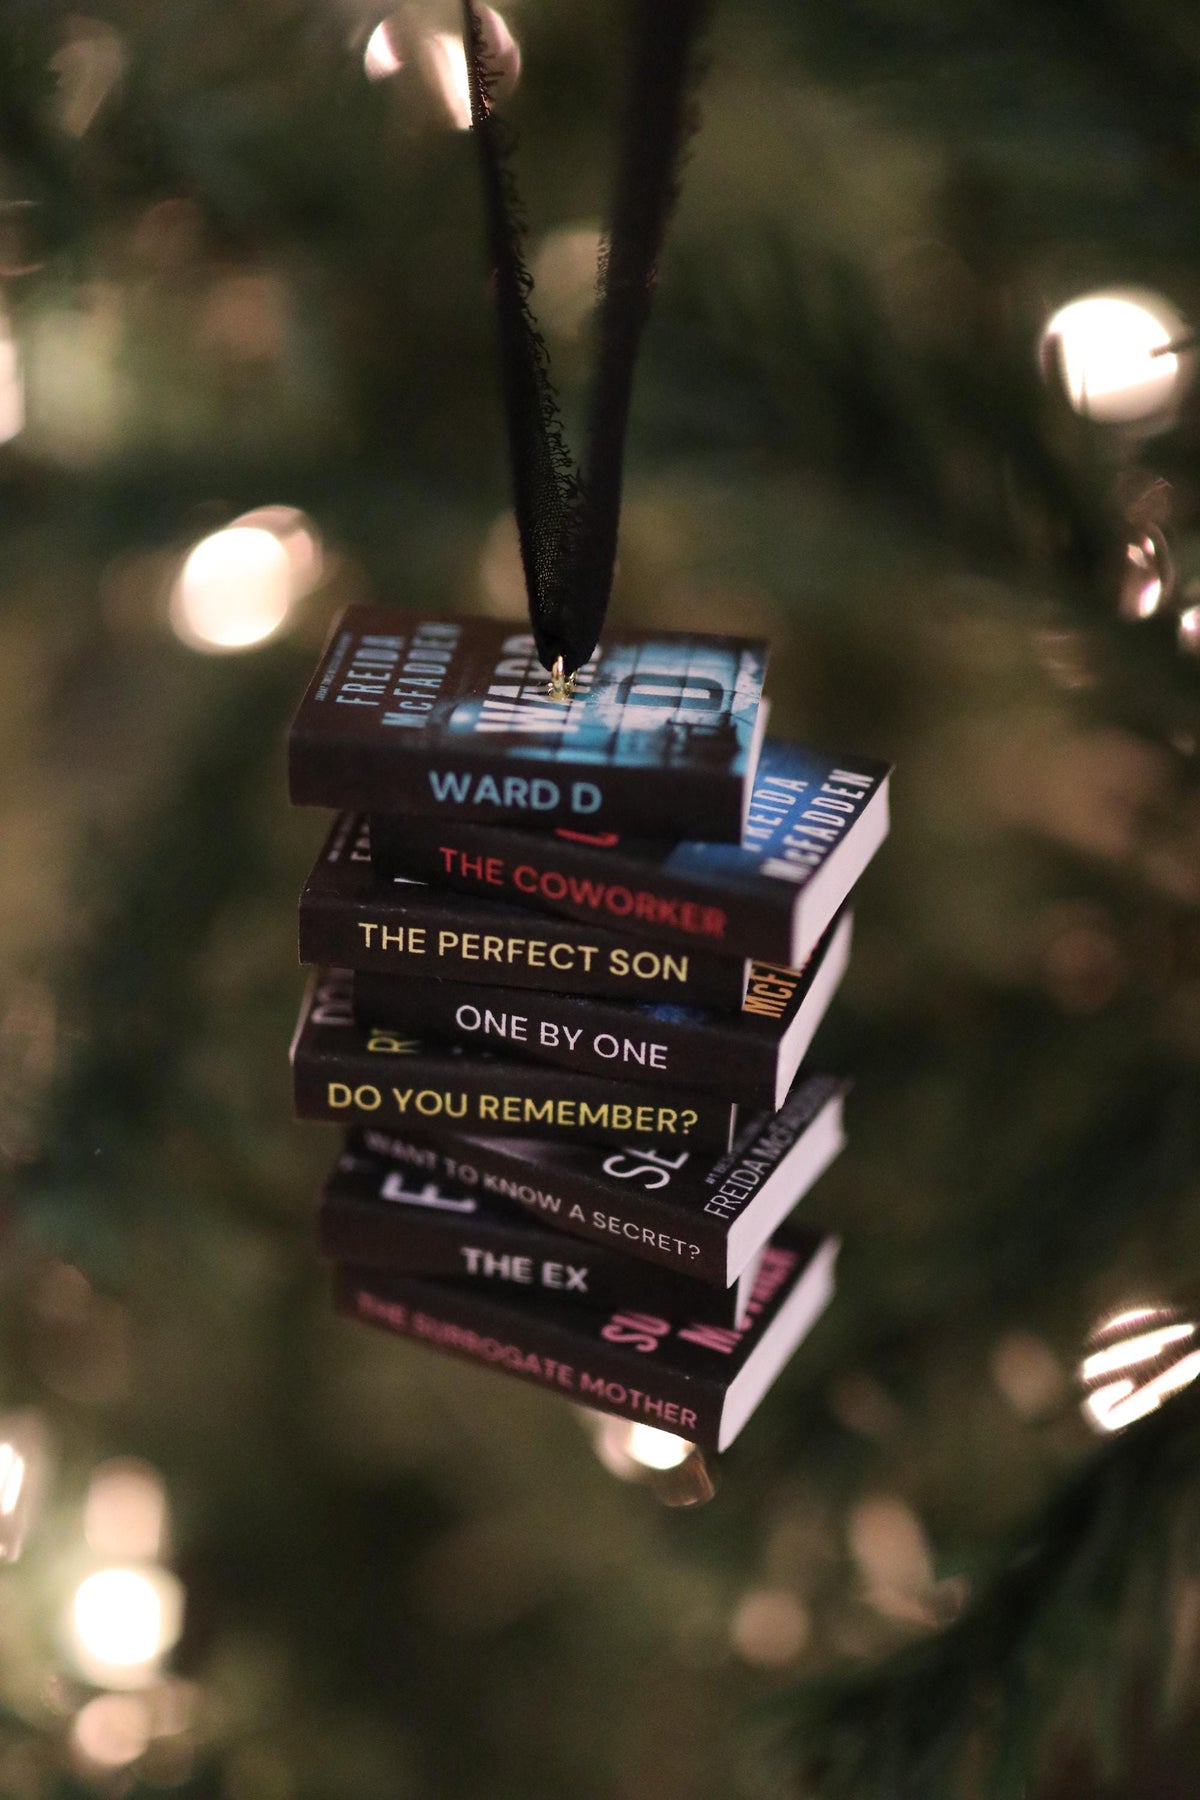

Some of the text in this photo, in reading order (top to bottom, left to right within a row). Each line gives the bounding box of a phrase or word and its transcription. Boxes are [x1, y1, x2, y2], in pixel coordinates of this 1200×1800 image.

[429, 769, 602, 815] WARD D
[439, 846, 727, 937] THE COWORKER
[358, 922, 689, 983] THE PERFECT SON
[455, 1004, 528, 1042] ONE
[540, 1021, 584, 1051] BY
[593, 1033, 668, 1070] ONE
[327, 1082, 699, 1135] DO YOU REMEMBER?
[444, 1157, 480, 1186] TO
[484, 1172, 561, 1214] KNOW
[569, 1203, 586, 1224] A
[592, 1210, 701, 1260] SECRET?
[703, 1158, 772, 1219] FREIDA
[460, 1246, 589, 1293] THE EX
[579, 1371, 698, 1430] MOTHER
